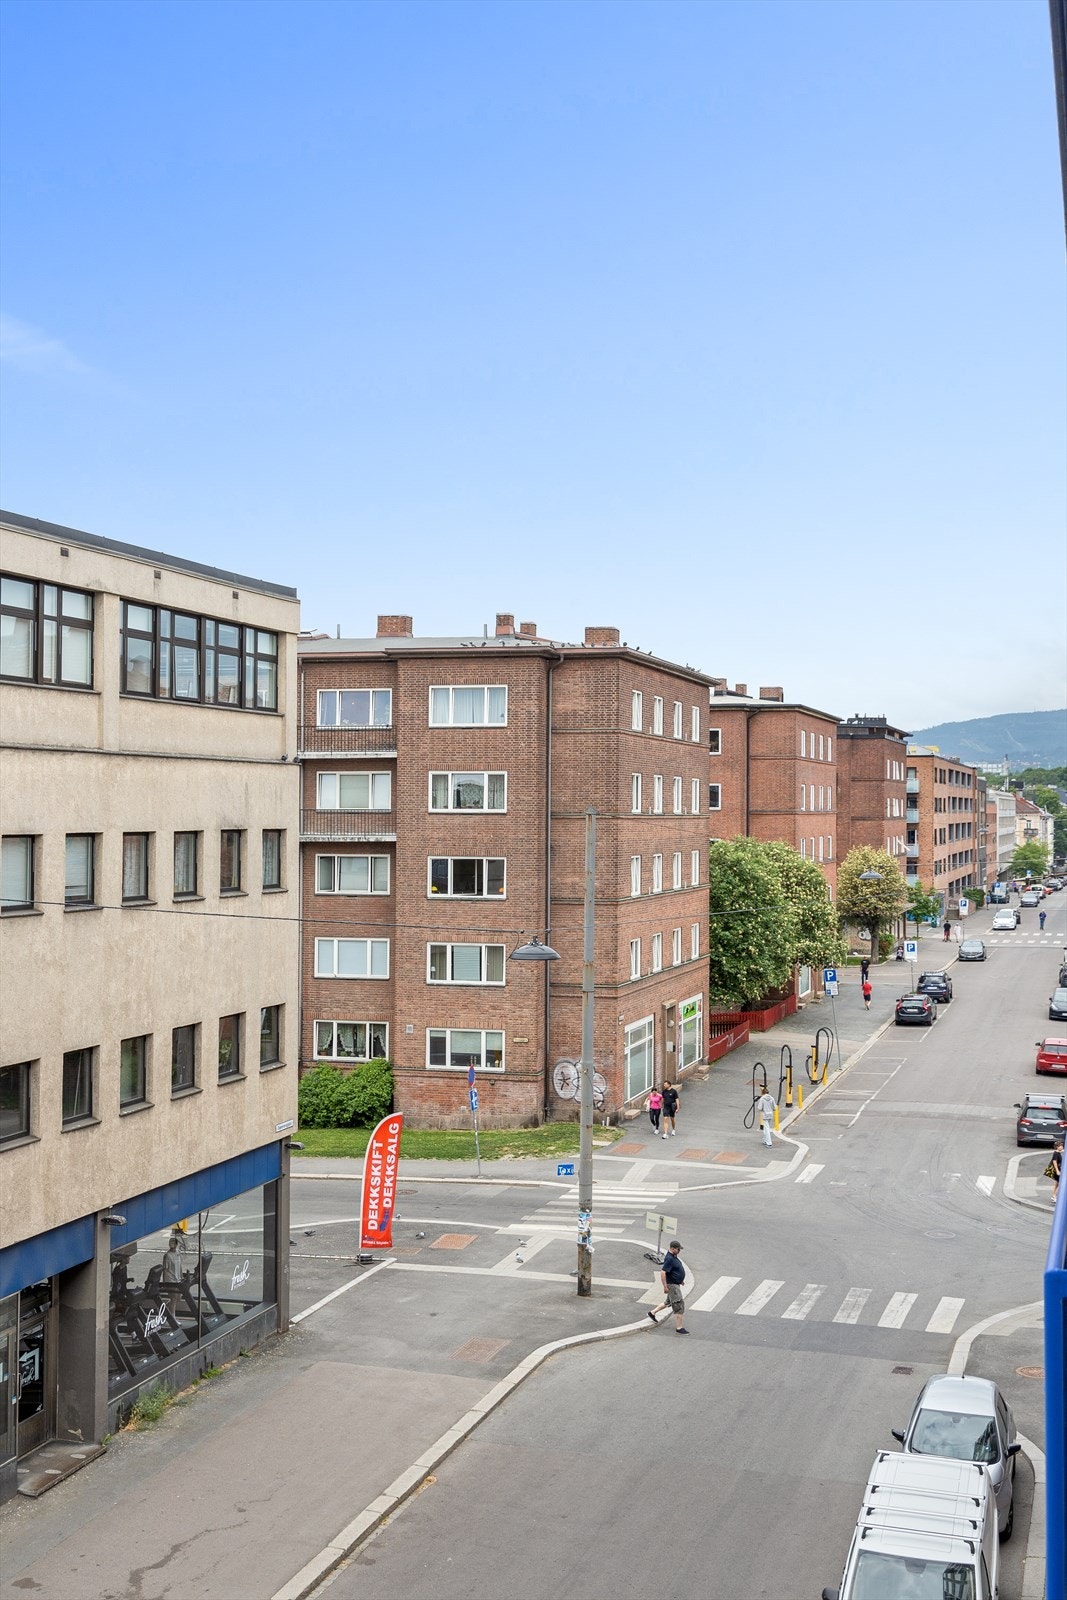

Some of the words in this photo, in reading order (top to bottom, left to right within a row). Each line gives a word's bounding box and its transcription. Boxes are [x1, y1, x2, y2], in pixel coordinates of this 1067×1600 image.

[908, 944, 914, 952] P
[826, 971, 834, 981] P
[383, 1122, 400, 1208] DEKKSALG
[367, 1139, 384, 1230] DEKKSKIFT
[230, 1259, 251, 1291] fresh
[144, 1302, 168, 1338] fresh
